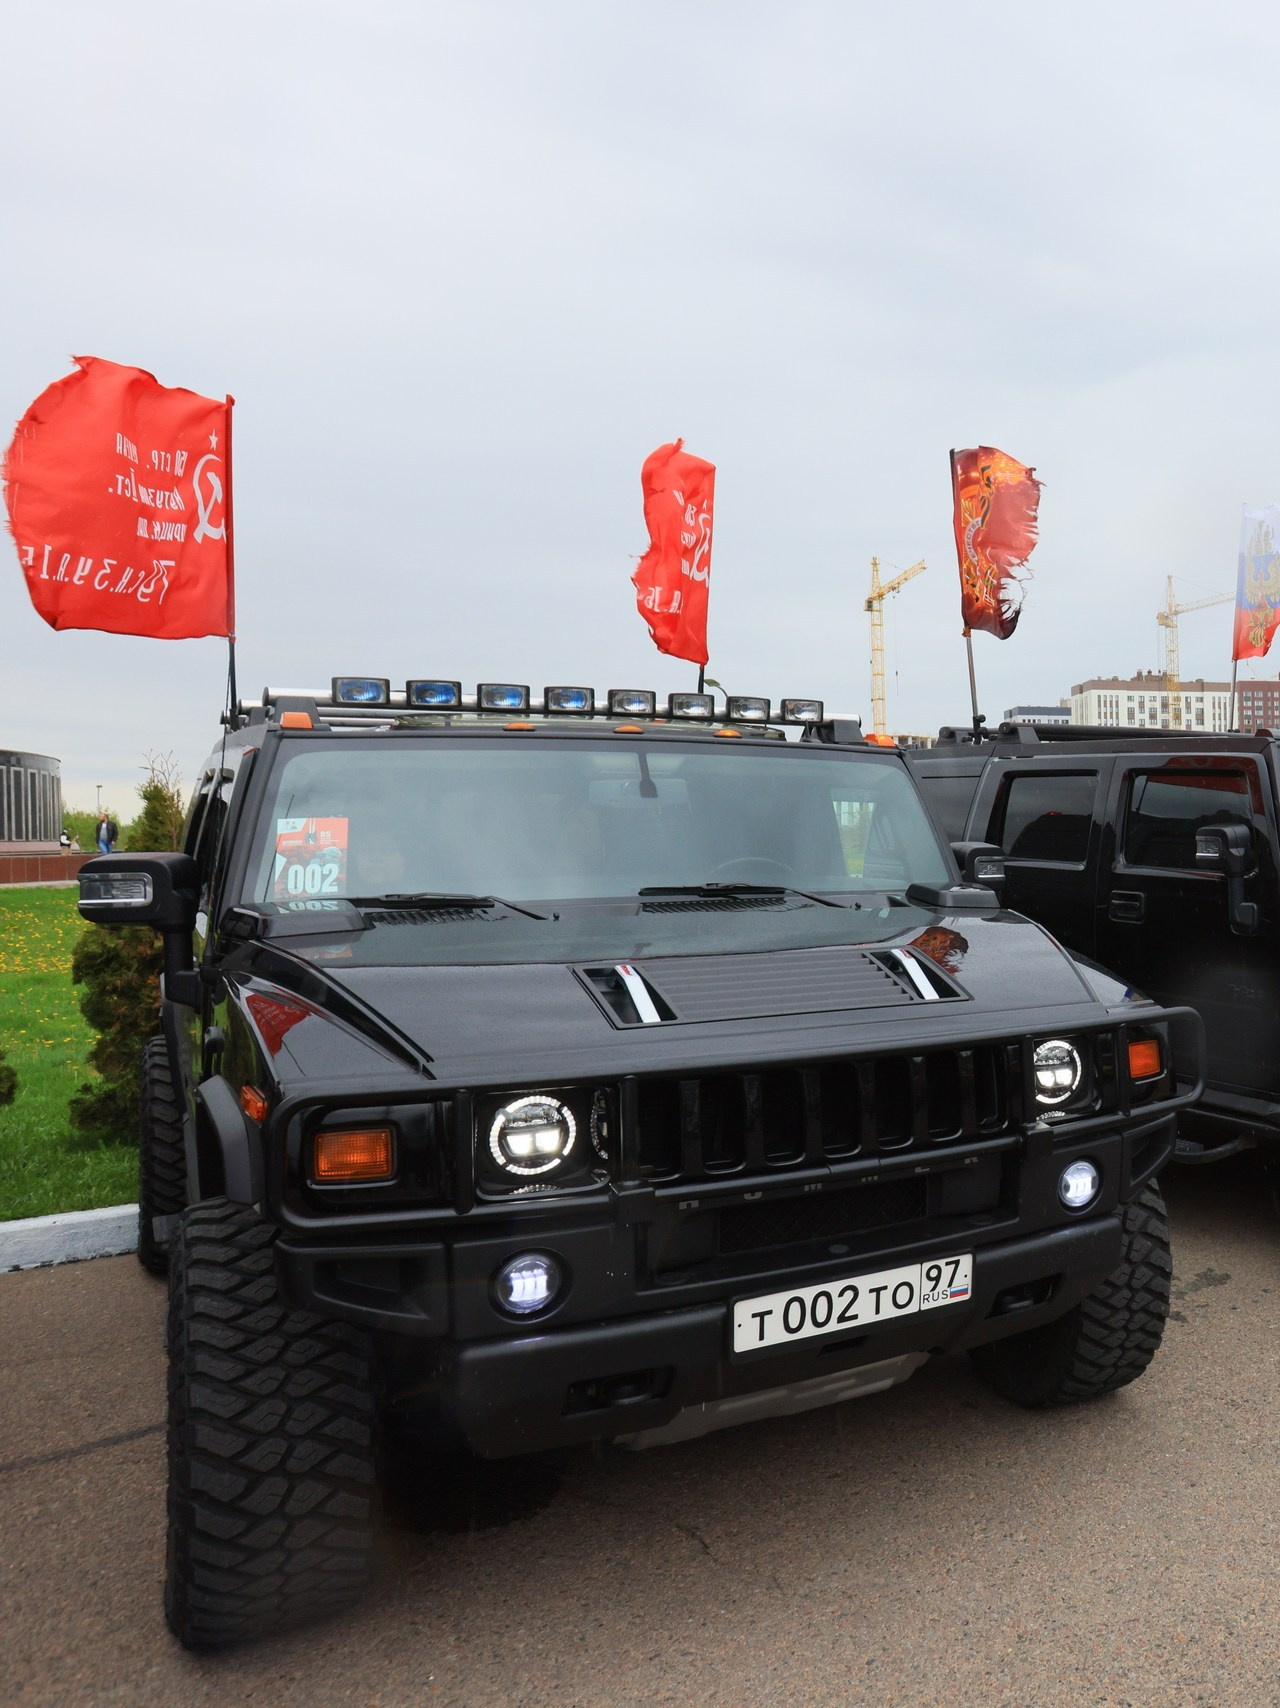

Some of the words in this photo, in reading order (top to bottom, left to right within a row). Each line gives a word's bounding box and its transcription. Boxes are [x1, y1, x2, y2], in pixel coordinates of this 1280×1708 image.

[287, 863, 339, 894] 002
[751, 1281, 915, 1342] Т002ТО
[925, 1259, 961, 1293] 97
[922, 1290, 949, 1304] RUS
